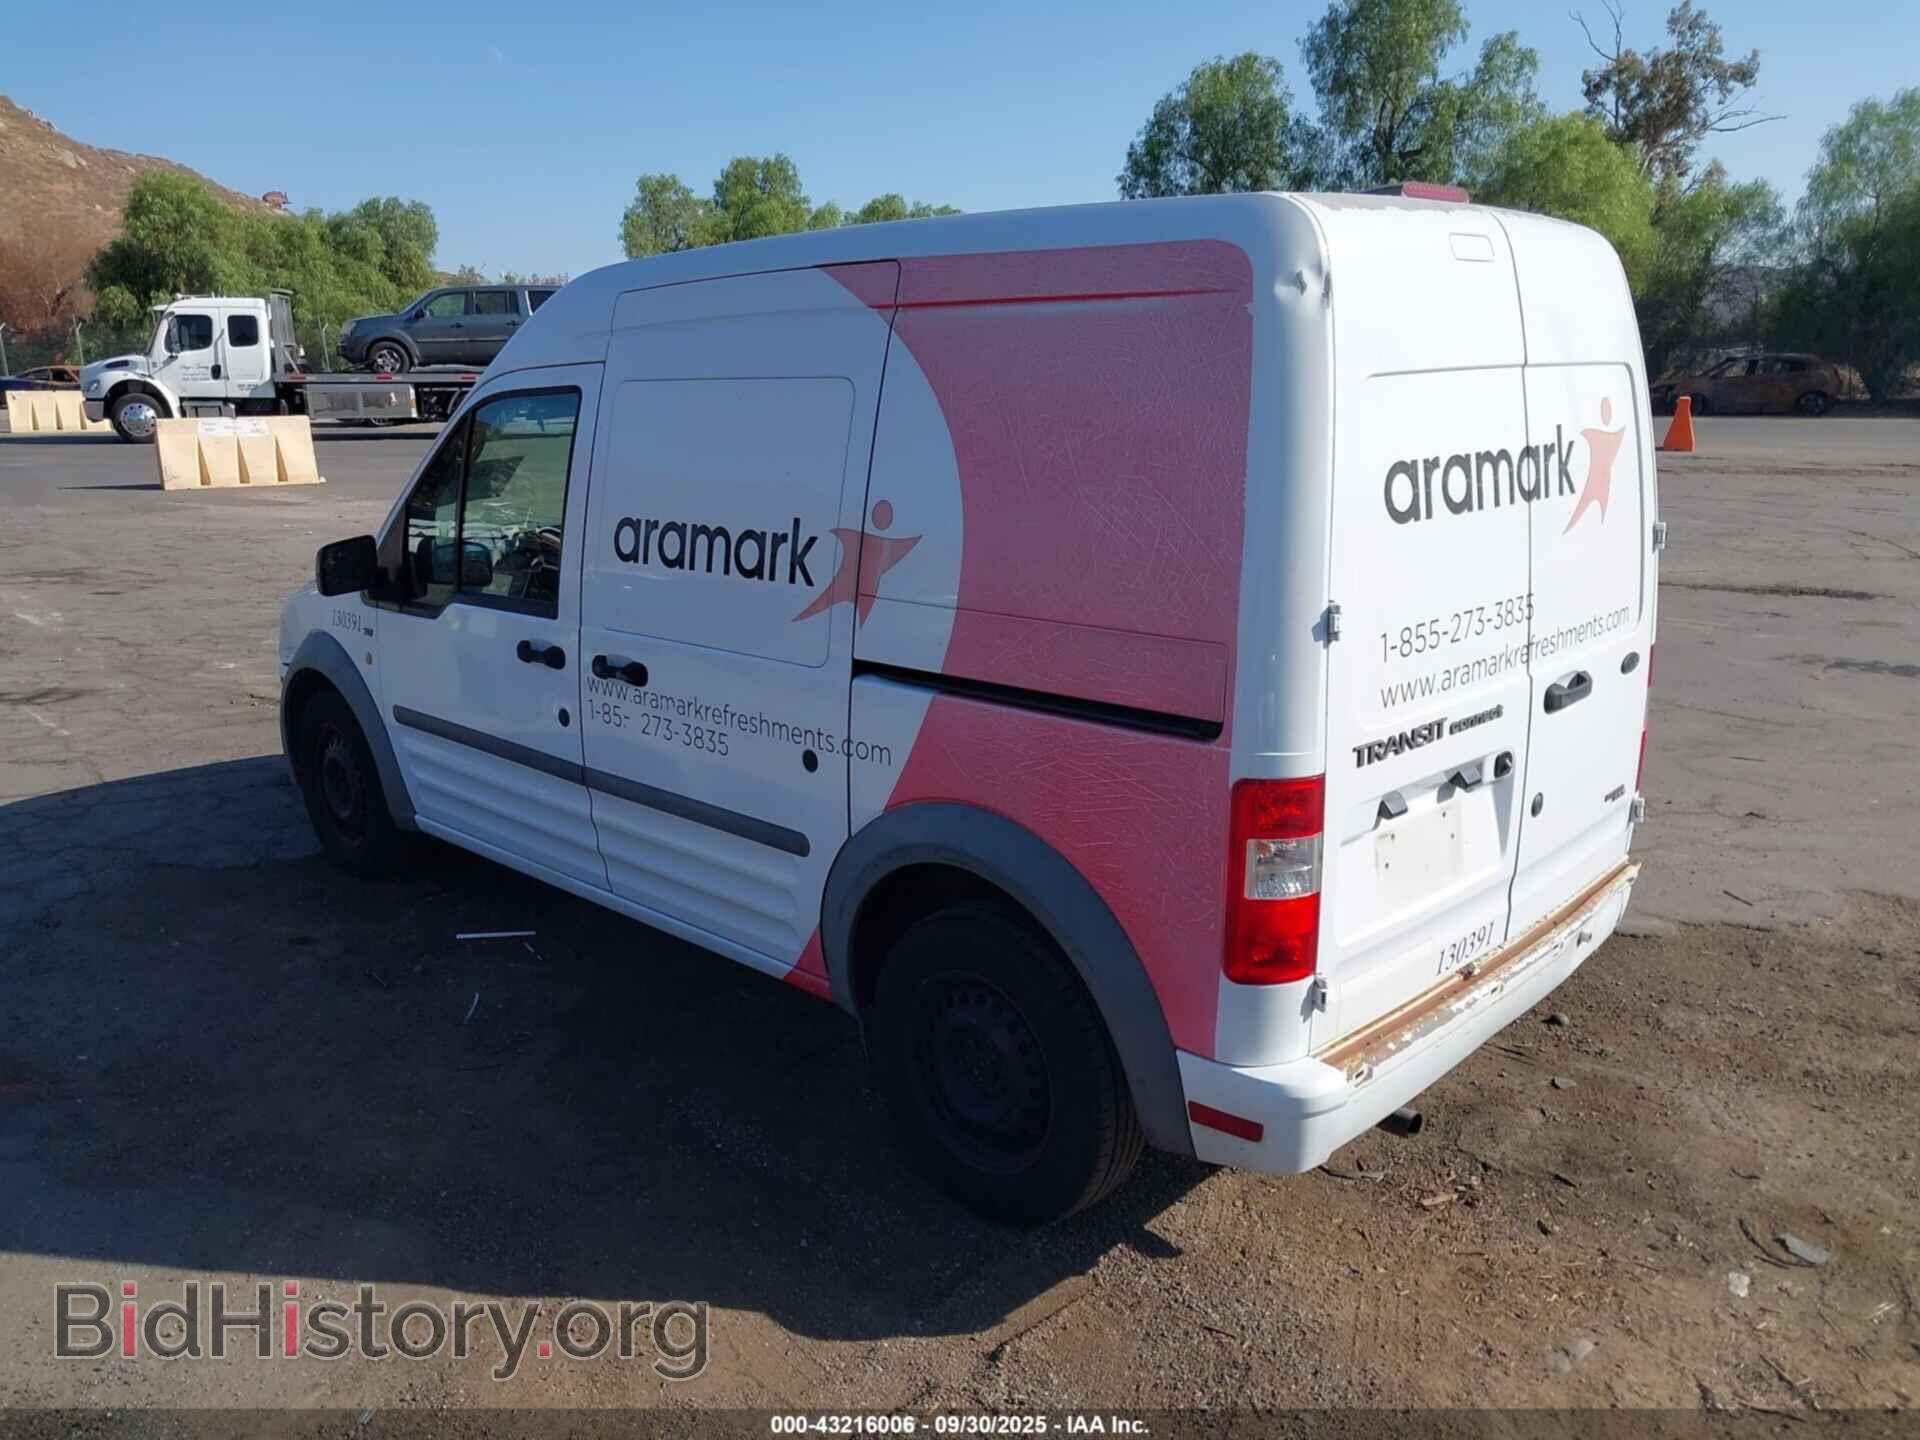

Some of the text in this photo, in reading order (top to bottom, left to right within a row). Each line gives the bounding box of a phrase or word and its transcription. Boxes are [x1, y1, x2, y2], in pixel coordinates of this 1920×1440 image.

[1383, 423, 1576, 526] aramark
[613, 515, 819, 588] aramark
[1379, 592, 1535, 665] 1-855-273-3835
[1380, 605, 1630, 709] www.aramarkrefreshments.com
[585, 675, 893, 767] www.aramarkrefreshments.com
[640, 711, 730, 757] 273-3835
[1352, 717, 1448, 768] TRANSIT
[1436, 921, 1494, 976] 130391
